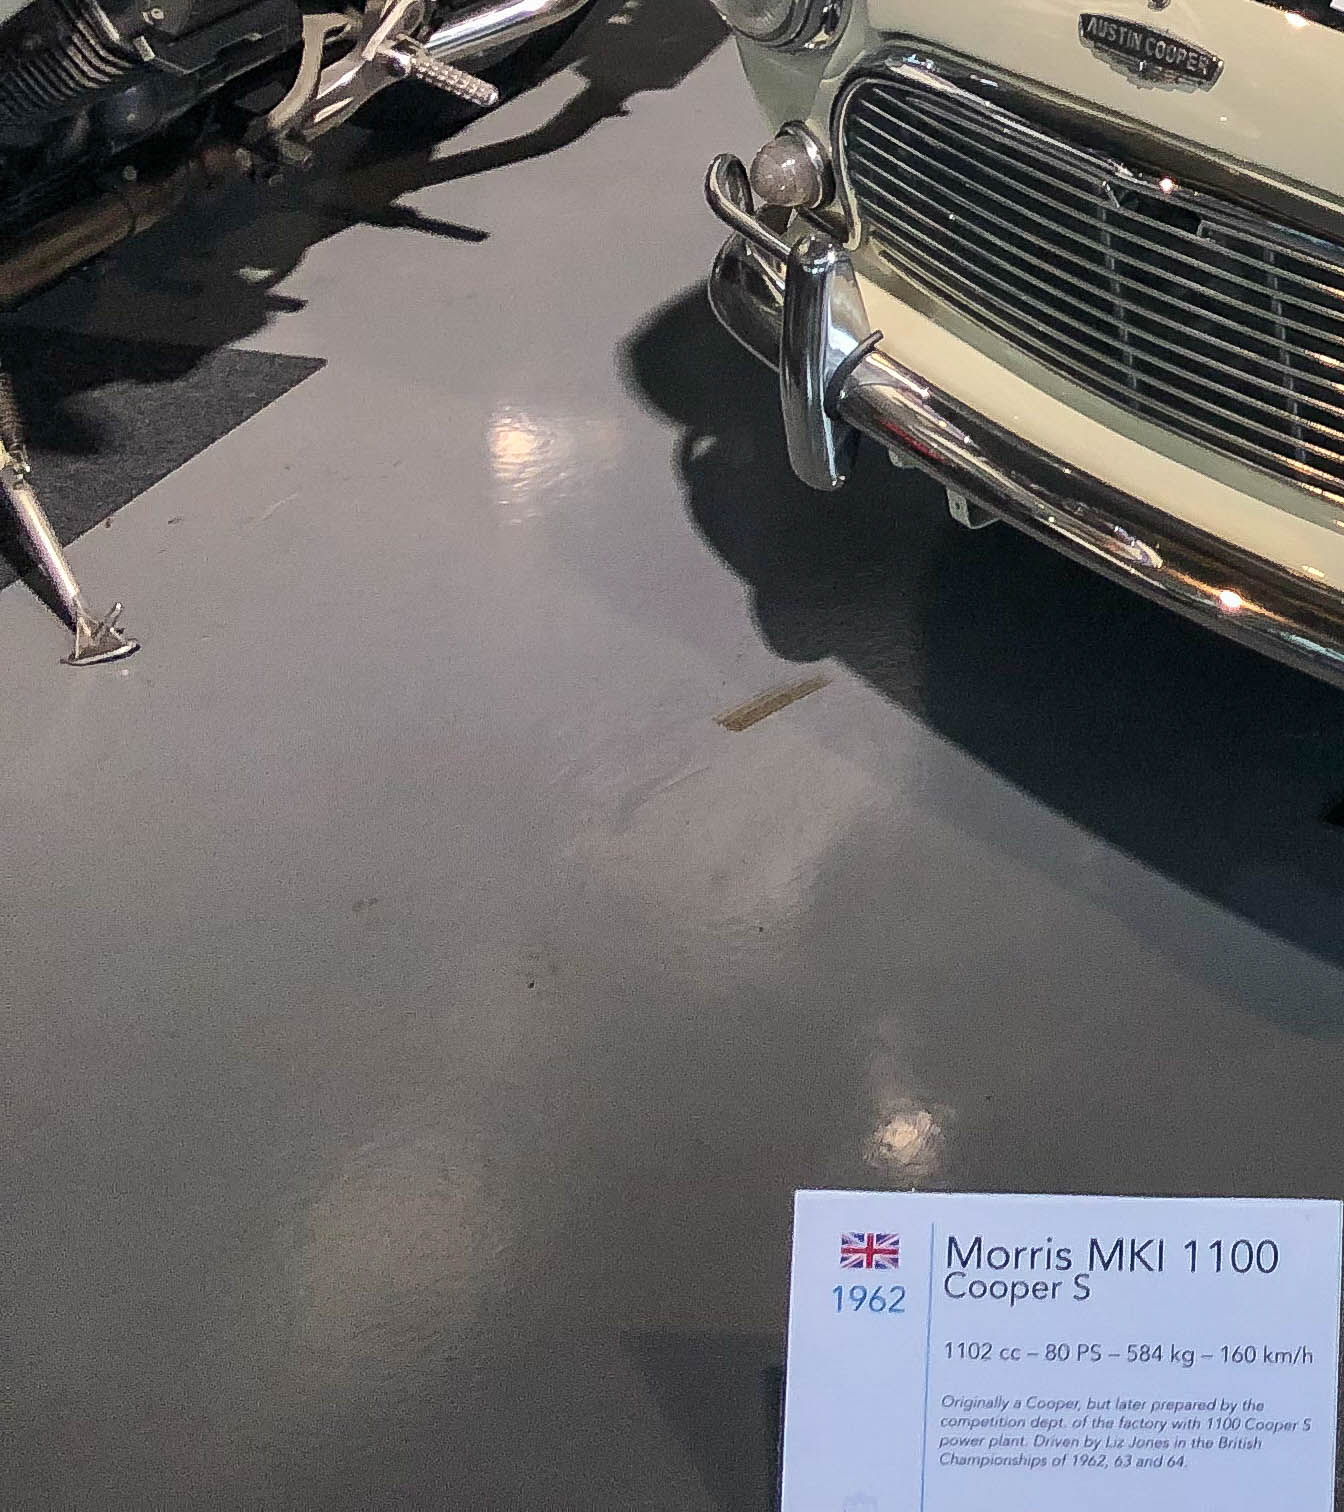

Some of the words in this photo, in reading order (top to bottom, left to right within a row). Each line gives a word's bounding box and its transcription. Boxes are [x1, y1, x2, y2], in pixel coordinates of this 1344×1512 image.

[1086, 16, 1143, 51] AUSTIN
[1144, 37, 1211, 77] COOPER
[946, 1236, 1073, 1271] Morris
[1088, 1237, 1164, 1273] MKI
[1184, 1239, 1279, 1274] 1100
[832, 1285, 906, 1314] 1962
[944, 1271, 1063, 1308] Cooper
[1073, 1272, 1091, 1302] S
[945, 1341, 993, 1361] 1102
[999, 1347, 1021, 1362] cc
[1044, 1343, 1071, 1362] 80
[1077, 1343, 1102, 1362] PS
[1127, 1343, 1162, 1363] 584
[1170, 1343, 1195, 1369] kg
[1221, 1345, 1257, 1364] 160
[1263, 1344, 1313, 1365] km/h
[941, 1394, 1010, 1413] Originally
[1012, 1399, 1022, 1409] a
[1025, 1395, 1081, 1413] Cooper,
[1086, 1397, 1111, 1411] but
[1115, 1397, 1147, 1411] later
[1150, 1397, 1218, 1414] prepared
[1219, 1397, 1238, 1416] by
[1242, 1398, 1265, 1412] the
[940, 1416, 1026, 1431] competition
[1030, 1415, 1067, 1432] dept.
[1071, 1414, 1090, 1429] of
[1091, 1415, 1115, 1429] the
[1118, 1415, 1168, 1433] factory
[1171, 1416, 1201, 1430] with
[1207, 1416, 1242, 1432] 1100
[1244, 1417, 1299, 1435] Cooper
[1302, 1418, 1312, 1432] S
[938, 1436, 985, 1449] power
[988, 1433, 1028, 1450] plant.
[1033, 1434, 1080, 1448] Driven
[1083, 1435, 1102, 1452] by
[1105, 1435, 1125, 1449] Liz
[1128, 1435, 1170, 1450] Jones
[1174, 1436, 1187, 1449] in
[1191, 1435, 1214, 1449] the
[1218, 1435, 1262, 1450] British
[939, 1452, 1048, 1470] Championships
[1051, 1453, 1067, 1467] of
[1072, 1453, 1109, 1470] 1962,
[1113, 1454, 1133, 1468] 63
[1135, 1454, 1164, 1468] and
[1166, 1455, 1188, 1468] 64.
